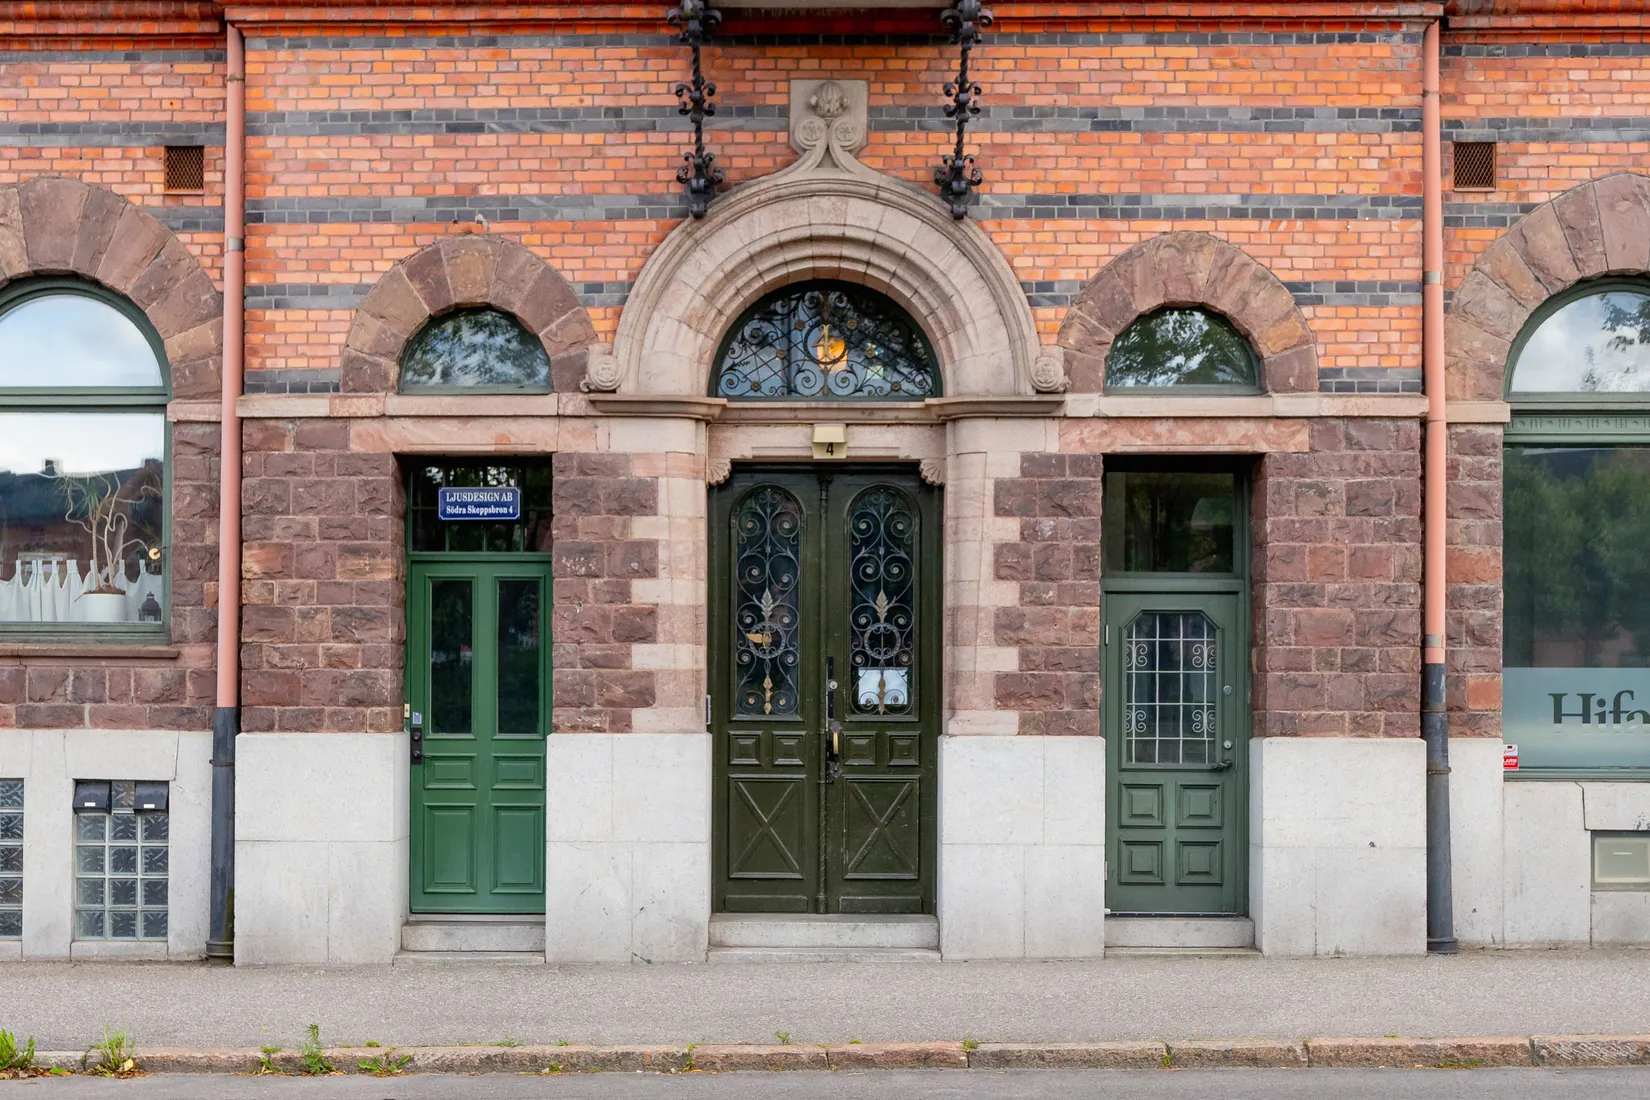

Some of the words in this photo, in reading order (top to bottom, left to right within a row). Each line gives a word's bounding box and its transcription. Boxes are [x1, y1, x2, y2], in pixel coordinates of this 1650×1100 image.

[812, 324, 834, 360] 4
[826, 443, 834, 456] 4
[446, 492, 500, 502] LJUSDESIGN
[501, 492, 513, 502] AB
[446, 505, 466, 514] Södra
[467, 505, 508, 516] Skeppsbron
[508, 505, 513, 514] 4
